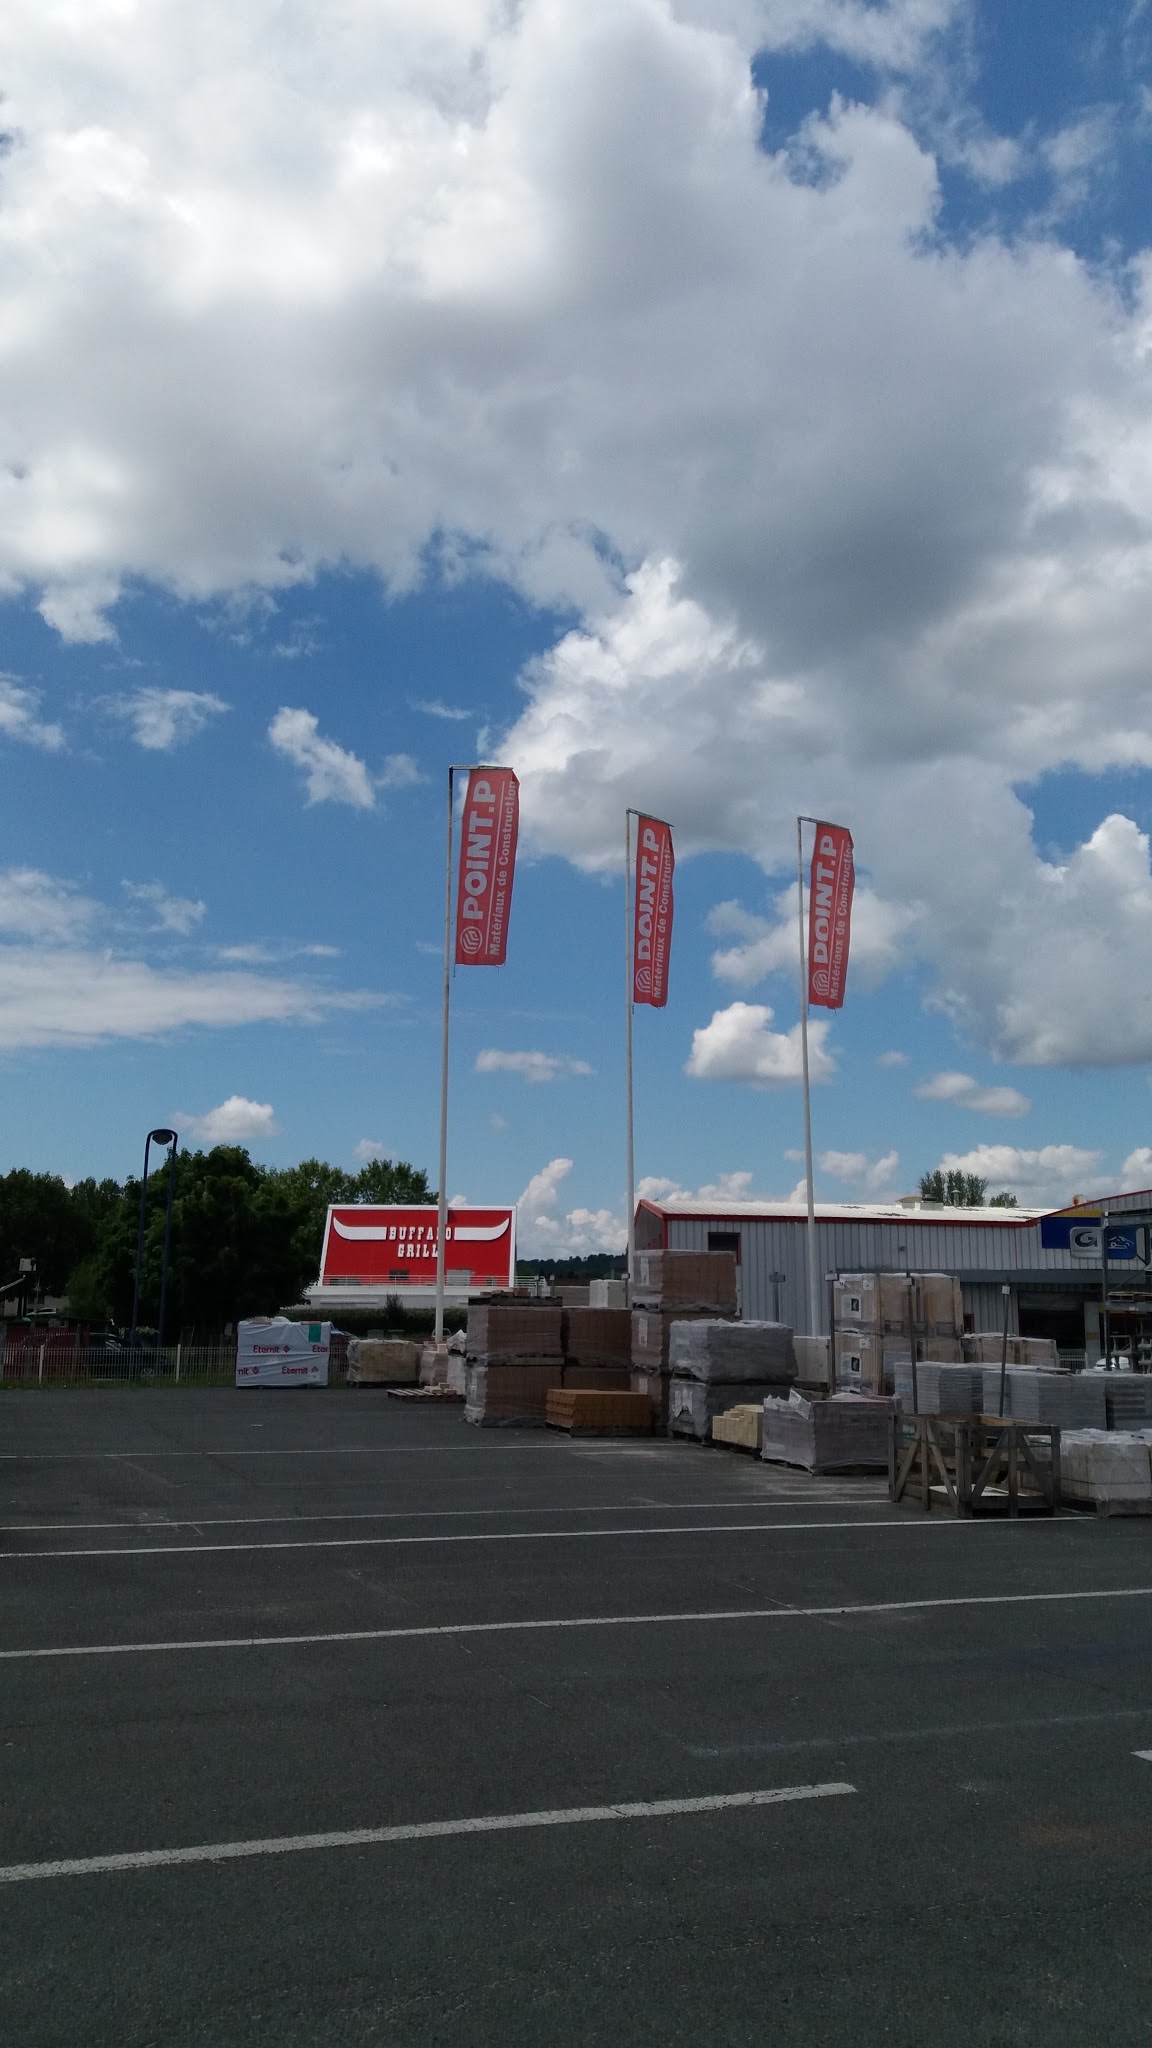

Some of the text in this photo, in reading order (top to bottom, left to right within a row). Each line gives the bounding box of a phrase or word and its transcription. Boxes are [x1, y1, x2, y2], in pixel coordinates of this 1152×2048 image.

[463, 780, 496, 920] POINT.P
[489, 780, 516, 956] Matériaux de Construction
[638, 828, 660, 960] POINT.P
[814, 835, 837, 964] POINT.P
[657, 919, 667, 933] de
[835, 921, 846, 935] de
[653, 938, 666, 998] Matériaux
[830, 940, 844, 1000] Matériaux
[397, 1243, 438, 1258] GRILL
[253, 1344, 280, 1353] Eternit
